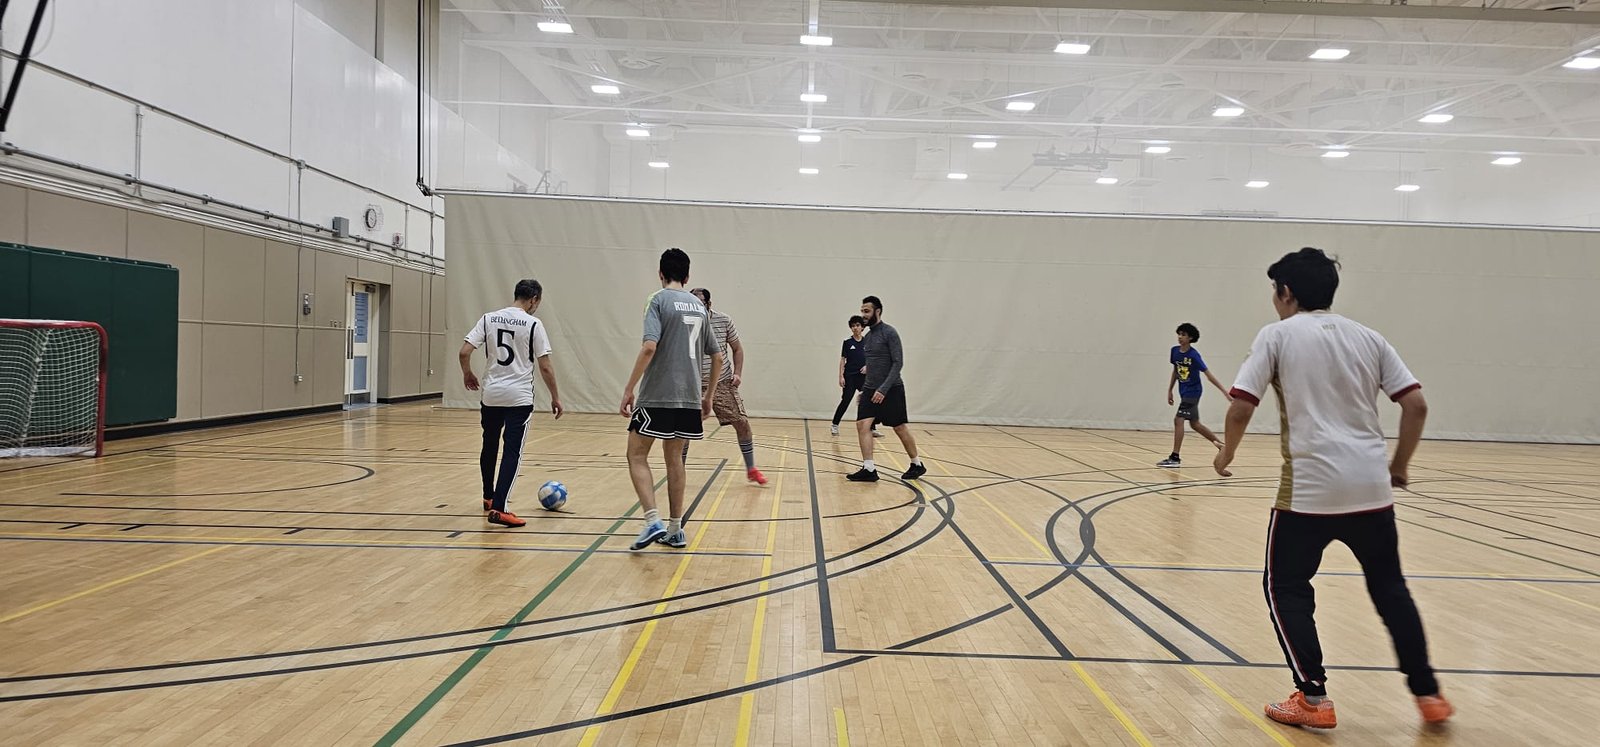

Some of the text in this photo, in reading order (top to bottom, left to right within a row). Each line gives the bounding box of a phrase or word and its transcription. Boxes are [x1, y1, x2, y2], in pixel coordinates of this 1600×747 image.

[490, 316, 527, 327] BELLINGHAM
[683, 315, 703, 359] 7
[497, 328, 515, 366] 5
